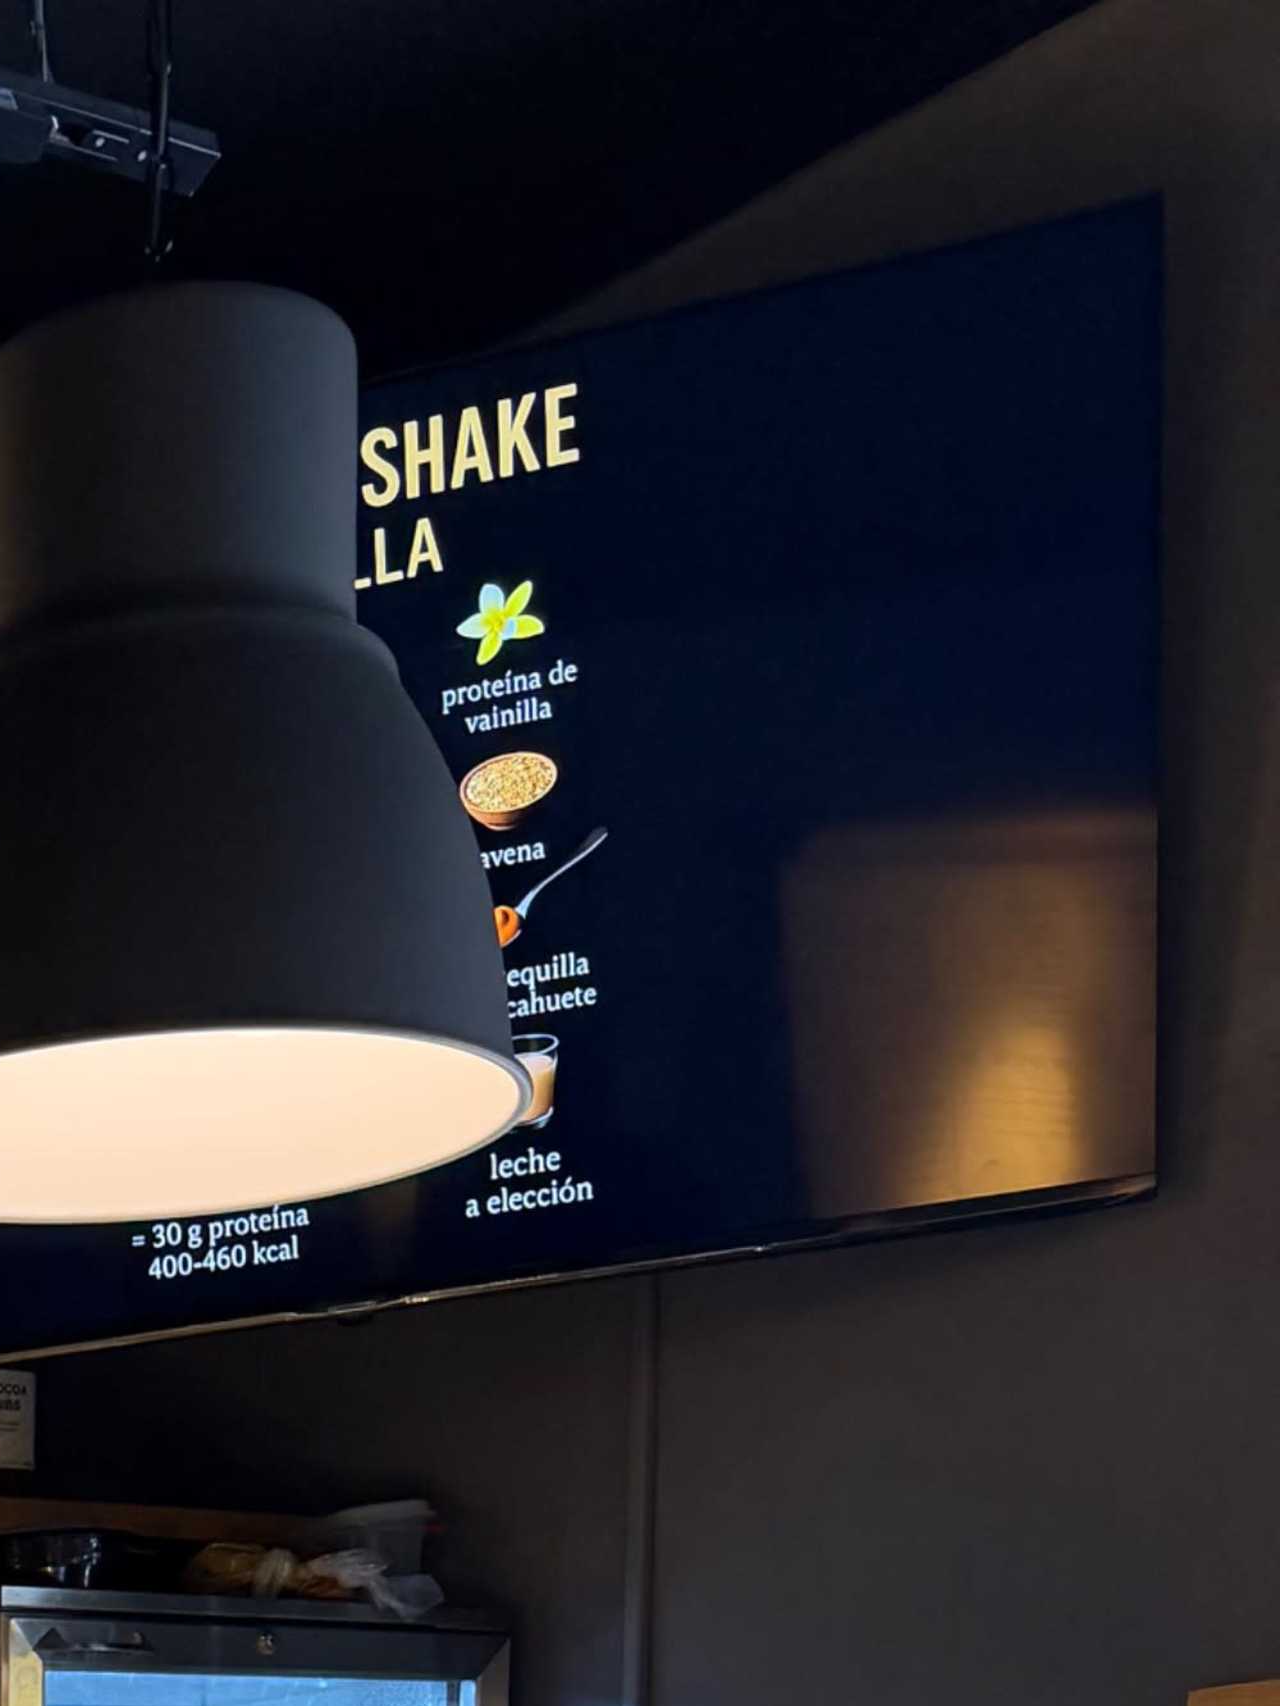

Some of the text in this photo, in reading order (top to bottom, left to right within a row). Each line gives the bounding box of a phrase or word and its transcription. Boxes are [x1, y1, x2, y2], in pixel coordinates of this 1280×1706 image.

[361, 382, 580, 507] SHAKE
[353, 517, 443, 590] LA
[441, 659, 578, 715] proteína de
[464, 697, 552, 734] vainilla
[507, 952, 590, 990] equilla
[508, 987, 597, 1018] cahuete
[489, 1148, 561, 1181] leche
[465, 1177, 594, 1218] a elección
[151, 1222, 182, 1250] 30
[188, 1224, 202, 1251] g
[209, 1205, 310, 1247] proteína
[148, 1235, 300, 1280] 400-460 kcal
